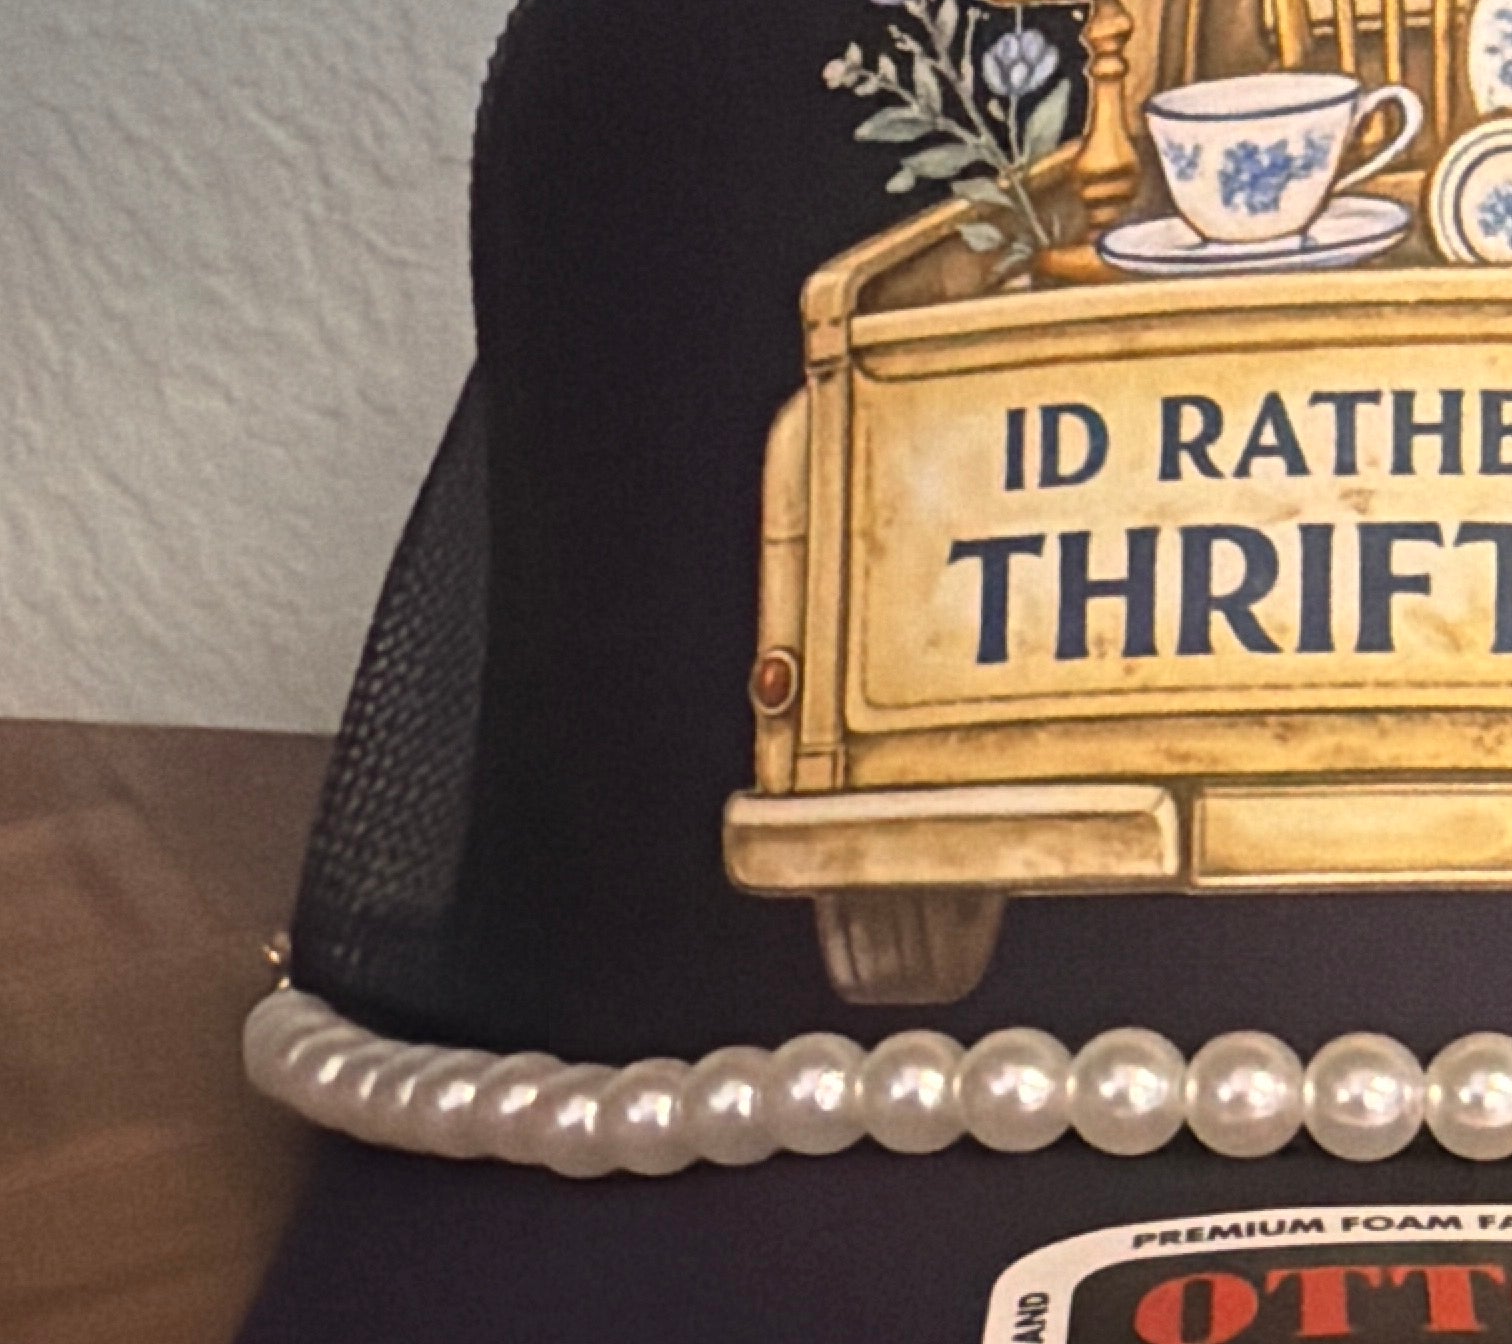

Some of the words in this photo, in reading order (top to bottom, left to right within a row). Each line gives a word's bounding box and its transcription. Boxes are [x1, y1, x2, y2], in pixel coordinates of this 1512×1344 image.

[1004, 401, 1110, 491] ID
[1132, 1216, 1326, 1250] PREMIUM
[1341, 1214, 1463, 1233] FOAM
